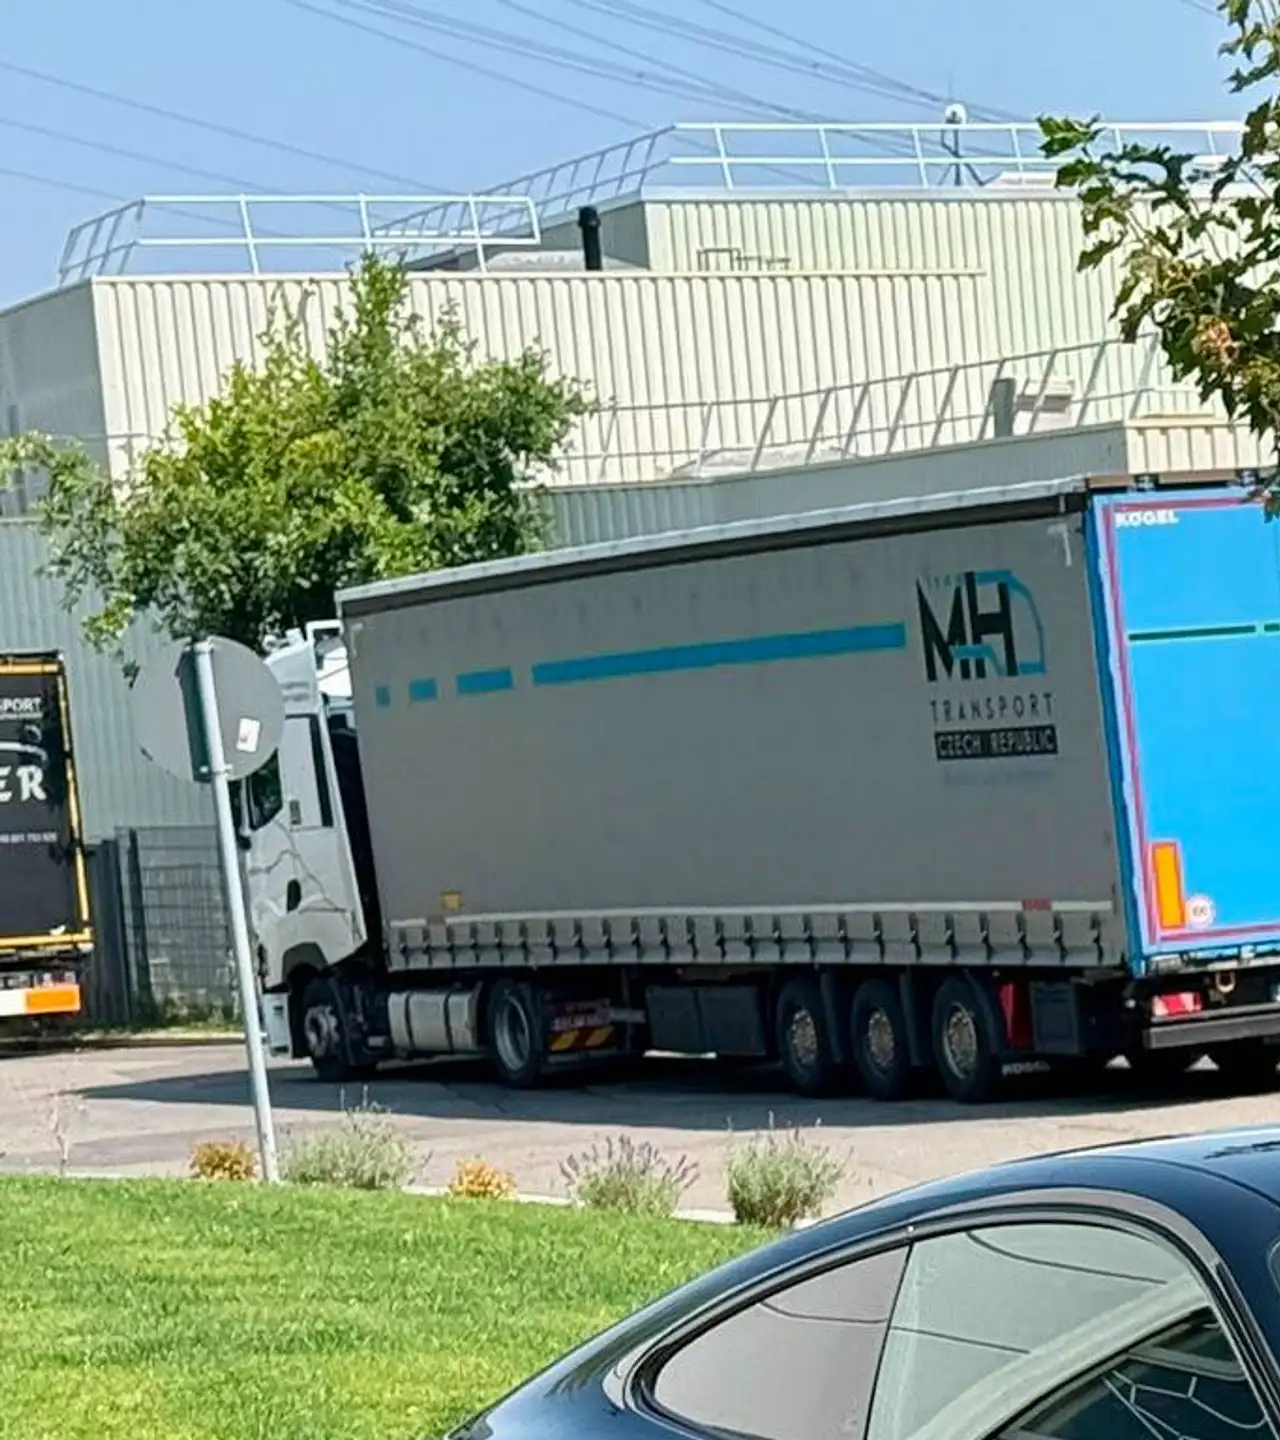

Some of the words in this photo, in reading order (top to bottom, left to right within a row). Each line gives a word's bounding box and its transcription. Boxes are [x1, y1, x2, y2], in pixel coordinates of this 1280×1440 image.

[930, 692, 1053, 722] TRANSPORT
[937, 734, 982, 756] CZECH
[990, 728, 1055, 753] REPUBLIC
